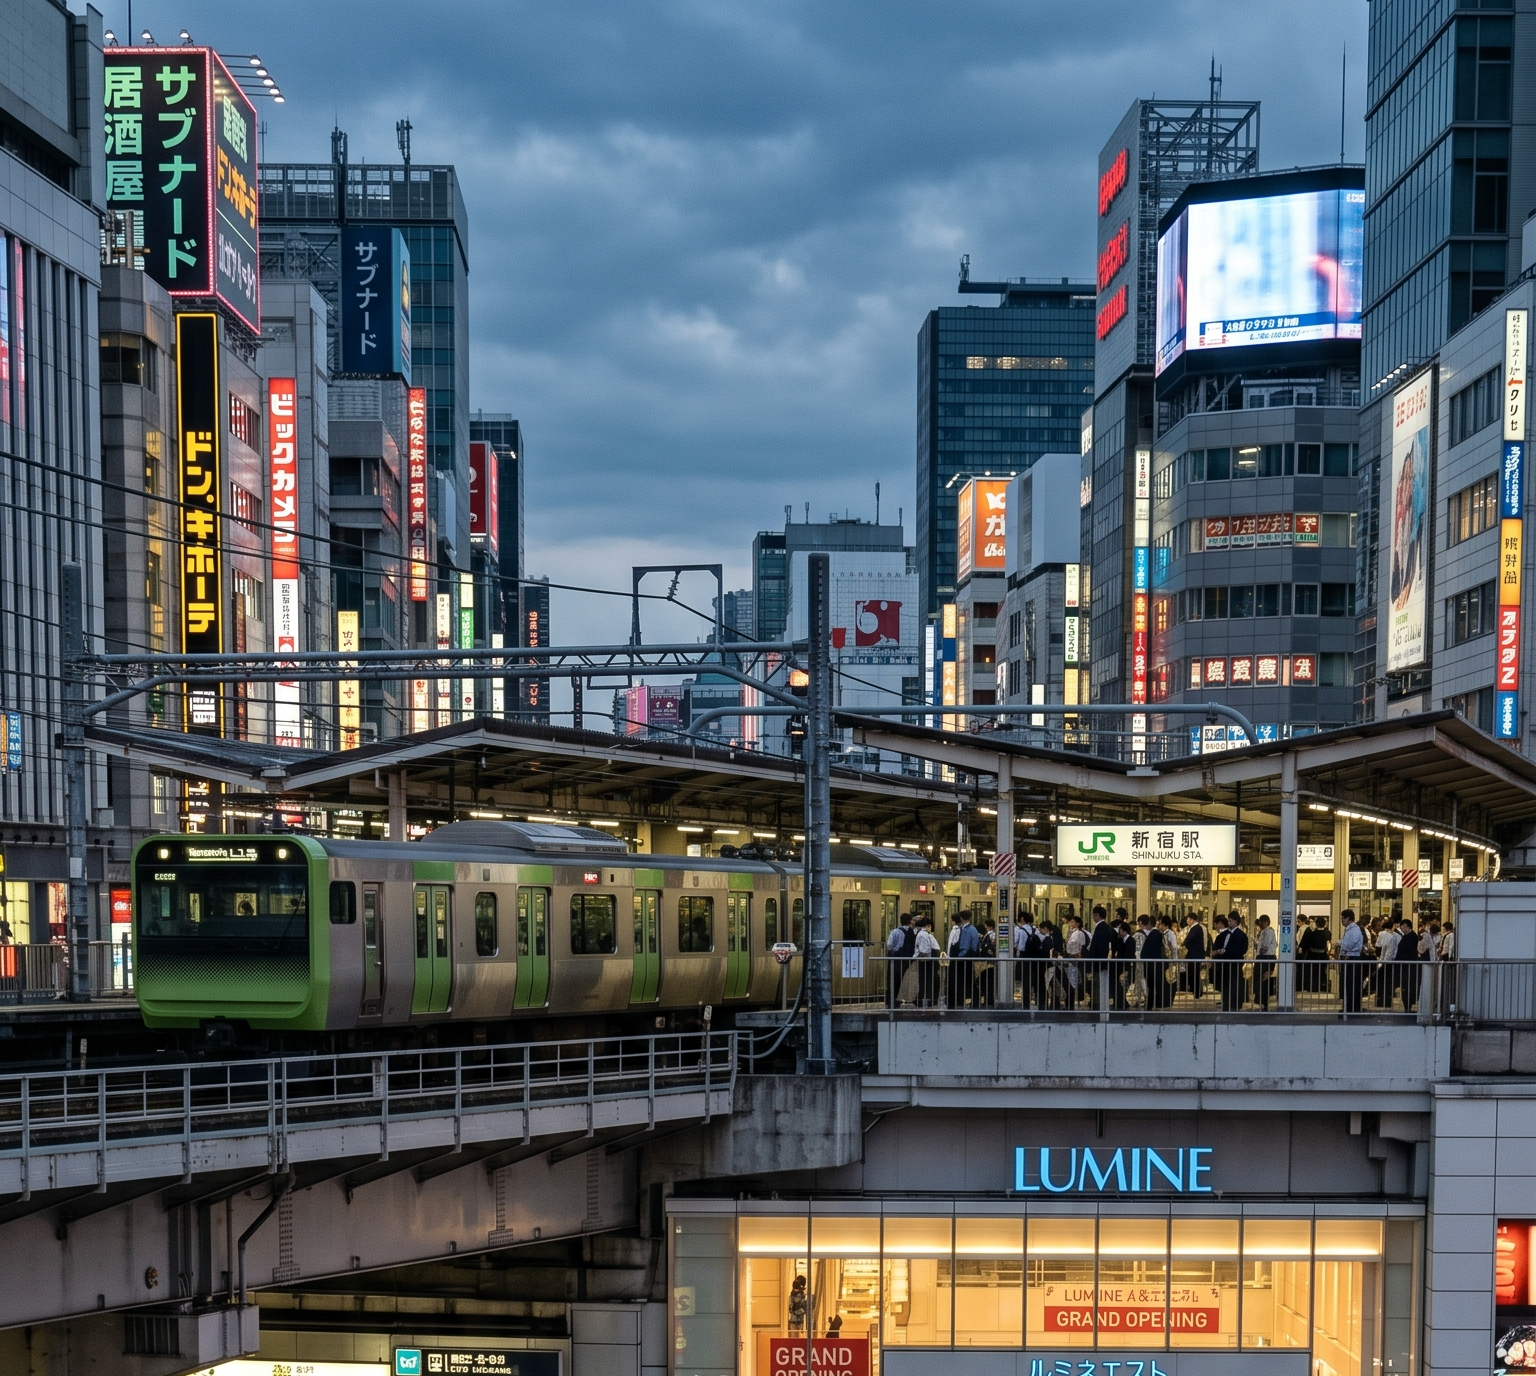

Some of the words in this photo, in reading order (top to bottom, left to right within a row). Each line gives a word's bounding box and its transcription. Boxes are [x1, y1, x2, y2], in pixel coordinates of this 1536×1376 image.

[104, 66, 143, 201] 居酒屋
[156, 66, 196, 279] サブナード
[355, 241, 378, 355] サブナード
[271, 393, 295, 543] ビックカメラ
[1078, 832, 1116, 854] JR
[1131, 831, 1200, 849] 新宿駅
[1131, 851, 1181, 860] SHINJUKU
[1183, 851, 1203, 860] STA.
[1015, 1147, 1212, 1192] LUMINE
[1064, 1289, 1123, 1302] LUMINE
[1056, 1311, 1120, 1327] GRAND
[1125, 1312, 1208, 1328] OPENING
[775, 1347, 853, 1366] GRAND
